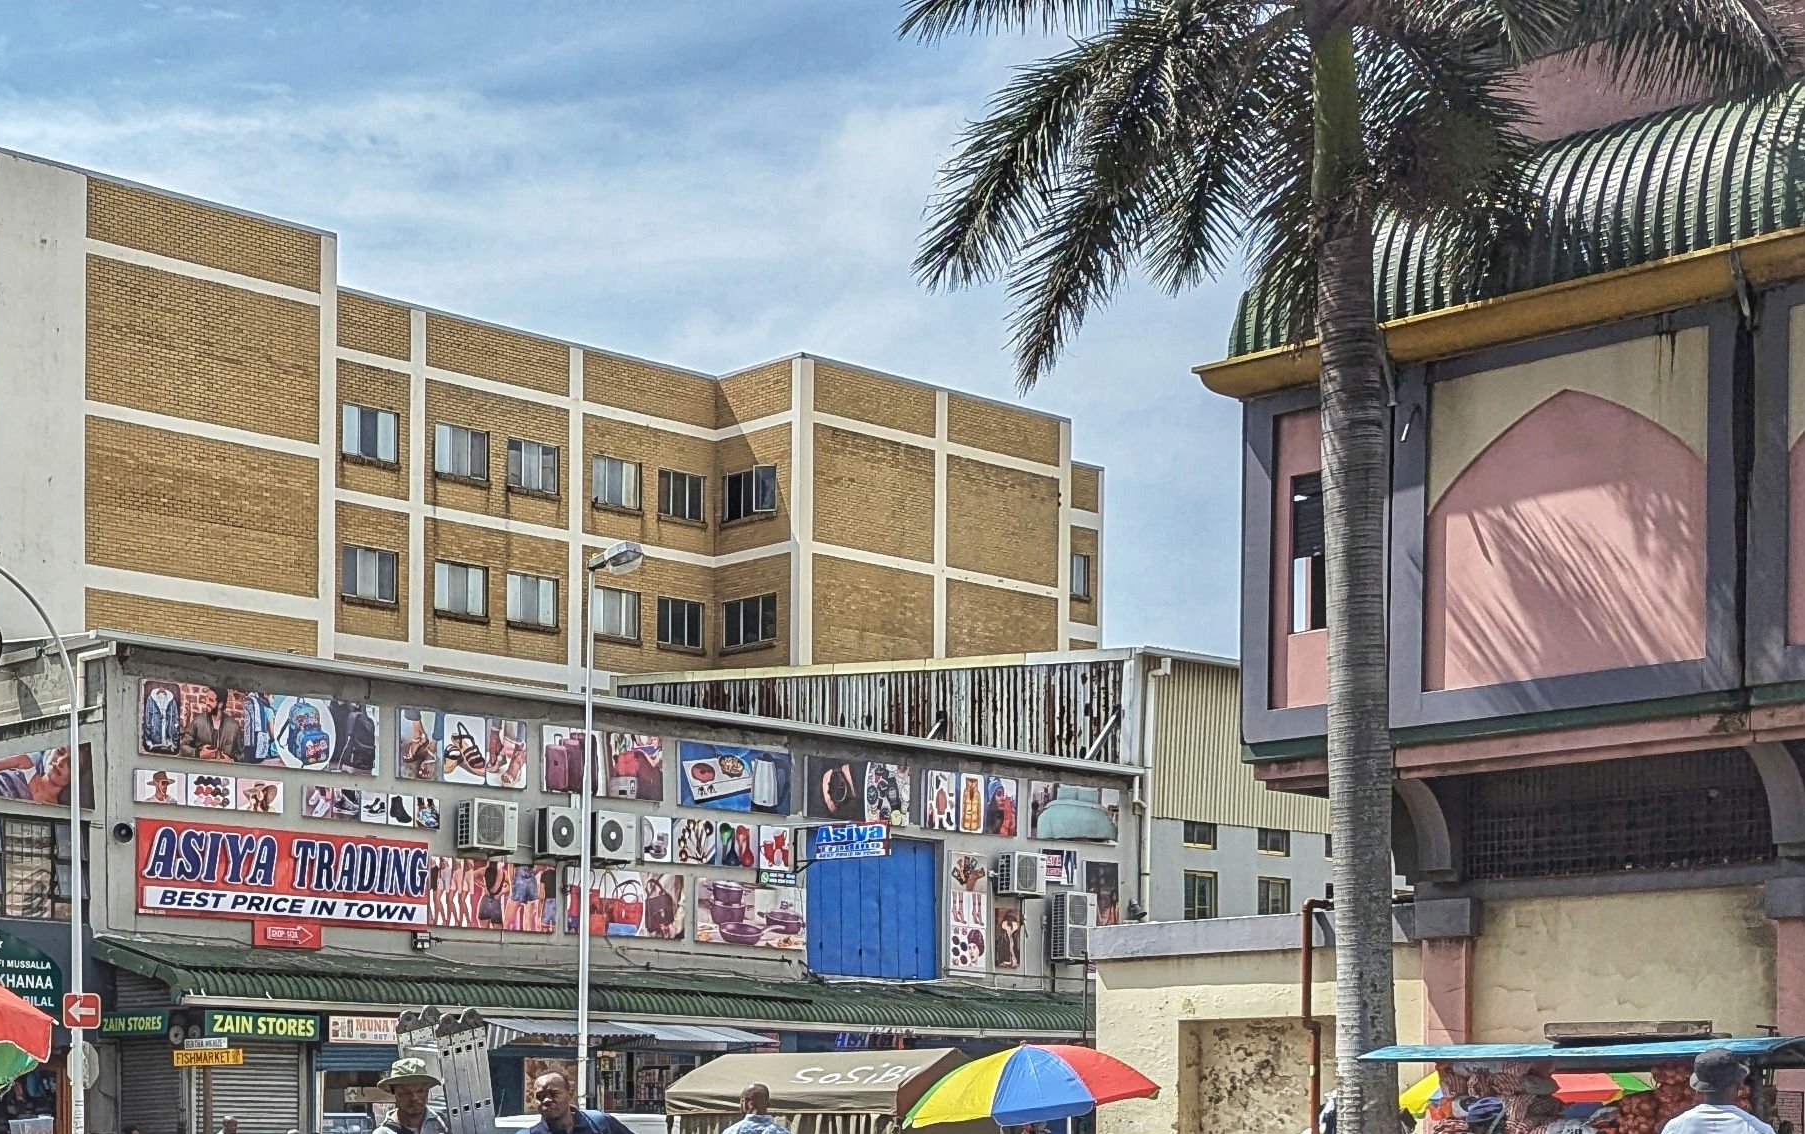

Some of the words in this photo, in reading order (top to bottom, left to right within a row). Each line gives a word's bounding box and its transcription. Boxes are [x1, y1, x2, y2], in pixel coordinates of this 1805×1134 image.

[816, 824, 883, 843] Asiya
[145, 827, 277, 886] ASIYA
[294, 839, 430, 897] TRADING
[159, 890, 226, 909] BEST
[231, 895, 304, 915] PRICE
[310, 900, 337, 916] IN
[344, 903, 417, 922] TOWN
[7, 959, 51, 969] MUSSALLA
[103, 1017, 126, 1032] ZAIN
[128, 1016, 162, 1031] STORES
[213, 1014, 252, 1033] ZAIN
[258, 1017, 315, 1037] STORES
[356, 1019, 389, 1032] MUNA
[176, 1051, 230, 1064] FISHMARKET
